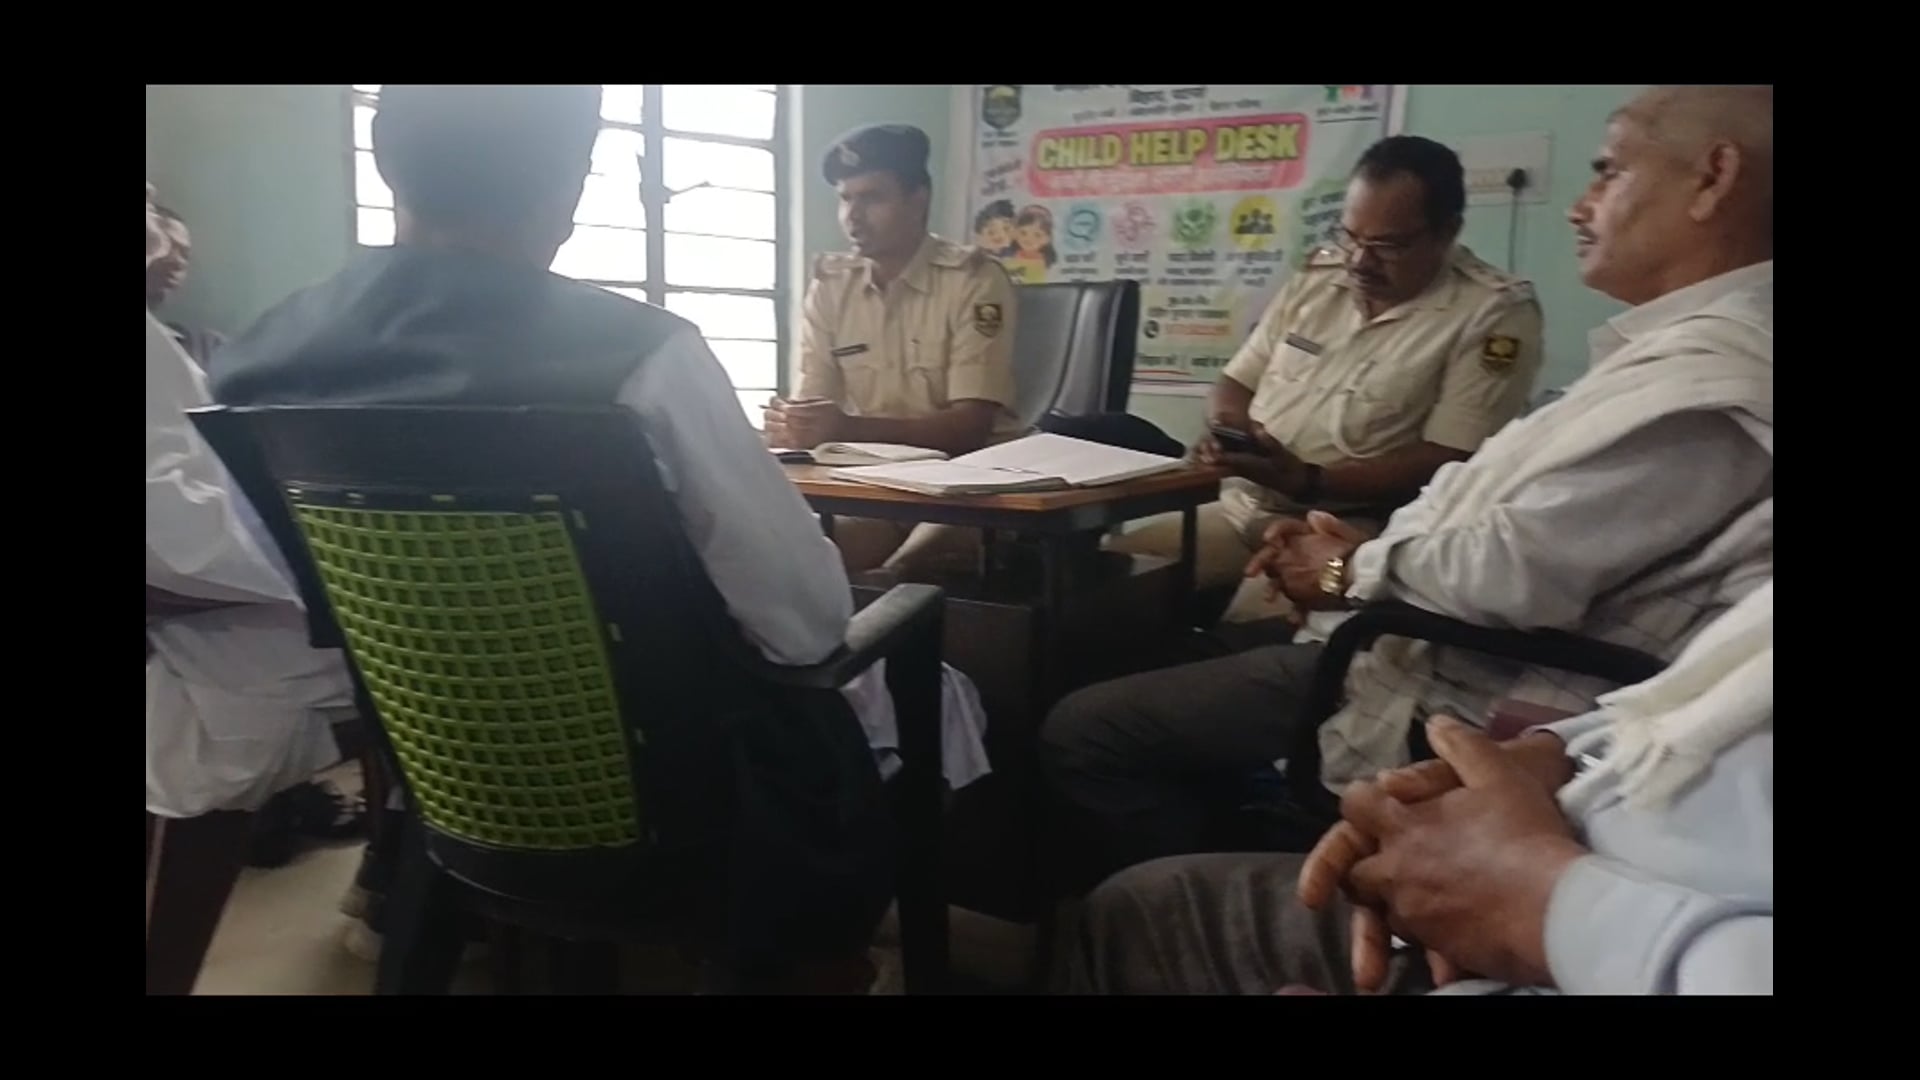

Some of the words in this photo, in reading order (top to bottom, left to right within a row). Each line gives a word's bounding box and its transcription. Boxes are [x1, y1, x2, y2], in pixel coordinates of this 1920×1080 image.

[1037, 134, 1122, 170] CHILD
[1128, 127, 1208, 167] HELP
[1214, 123, 1299, 160] DESK
